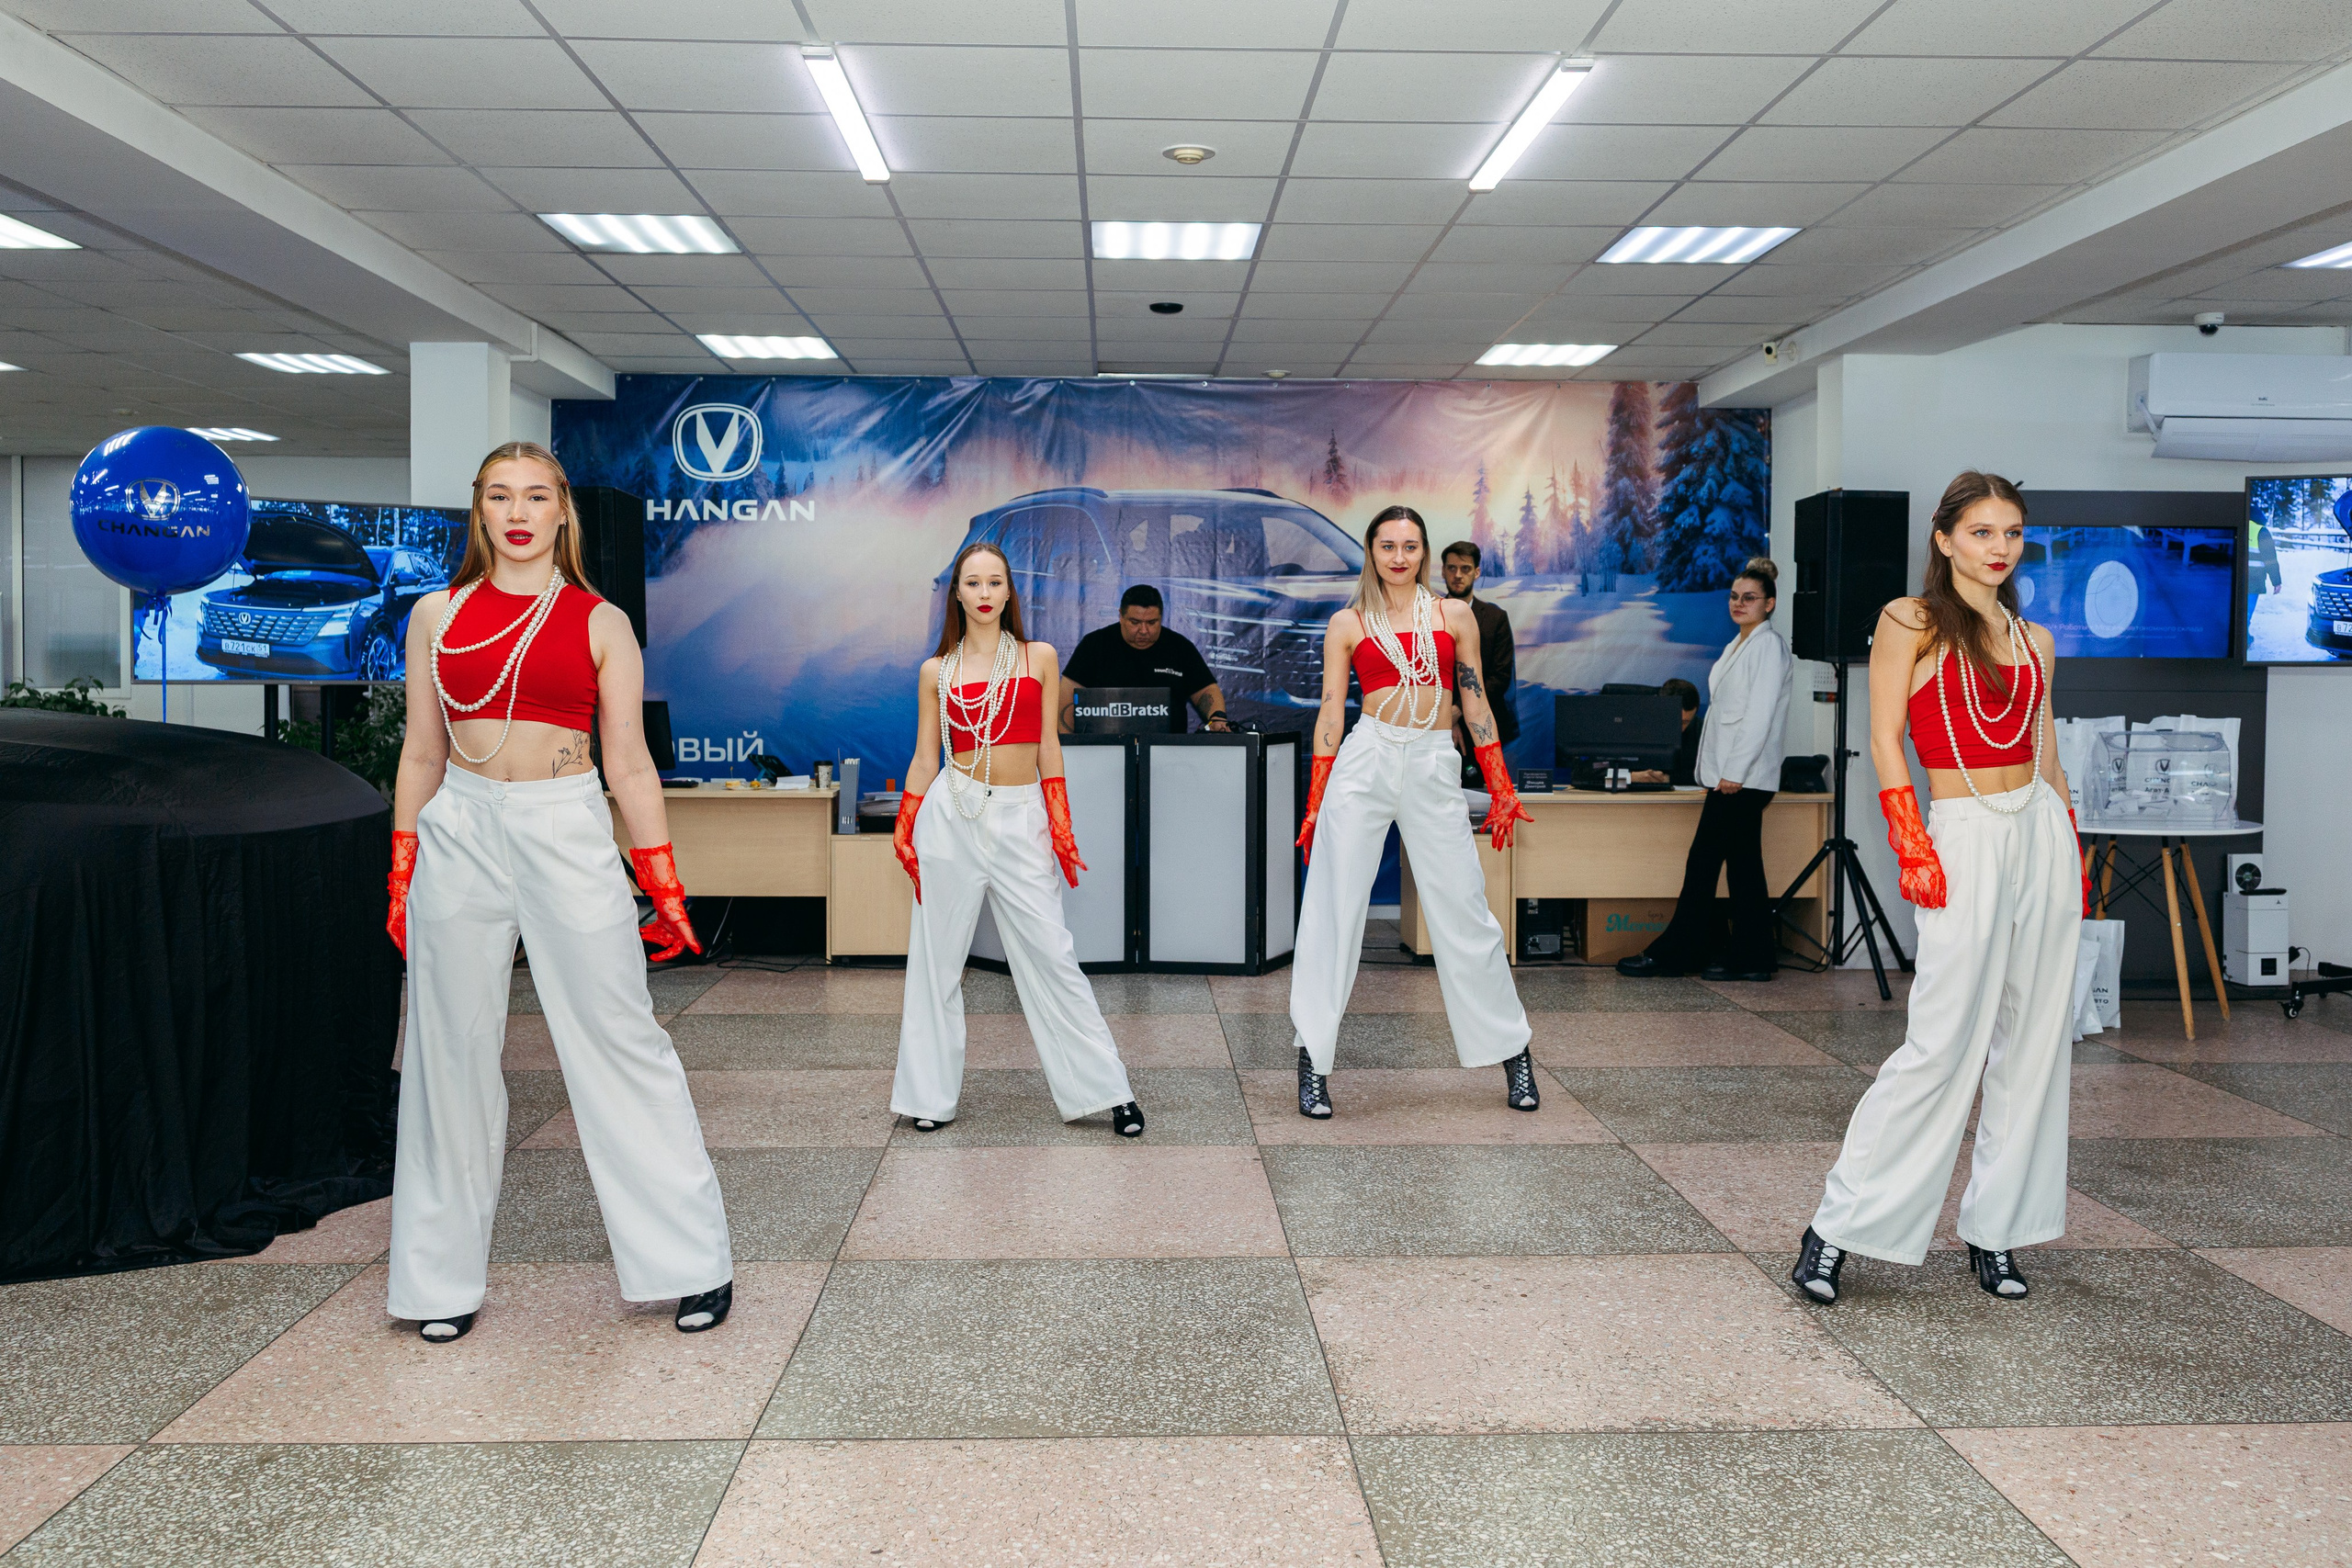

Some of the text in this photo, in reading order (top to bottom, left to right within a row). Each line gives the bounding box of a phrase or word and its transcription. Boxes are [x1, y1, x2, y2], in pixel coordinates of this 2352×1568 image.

[646, 499, 815, 521] HANGAN
[97, 519, 210, 538] CHANGAN
[673, 730, 763, 762] ВЫЙ
